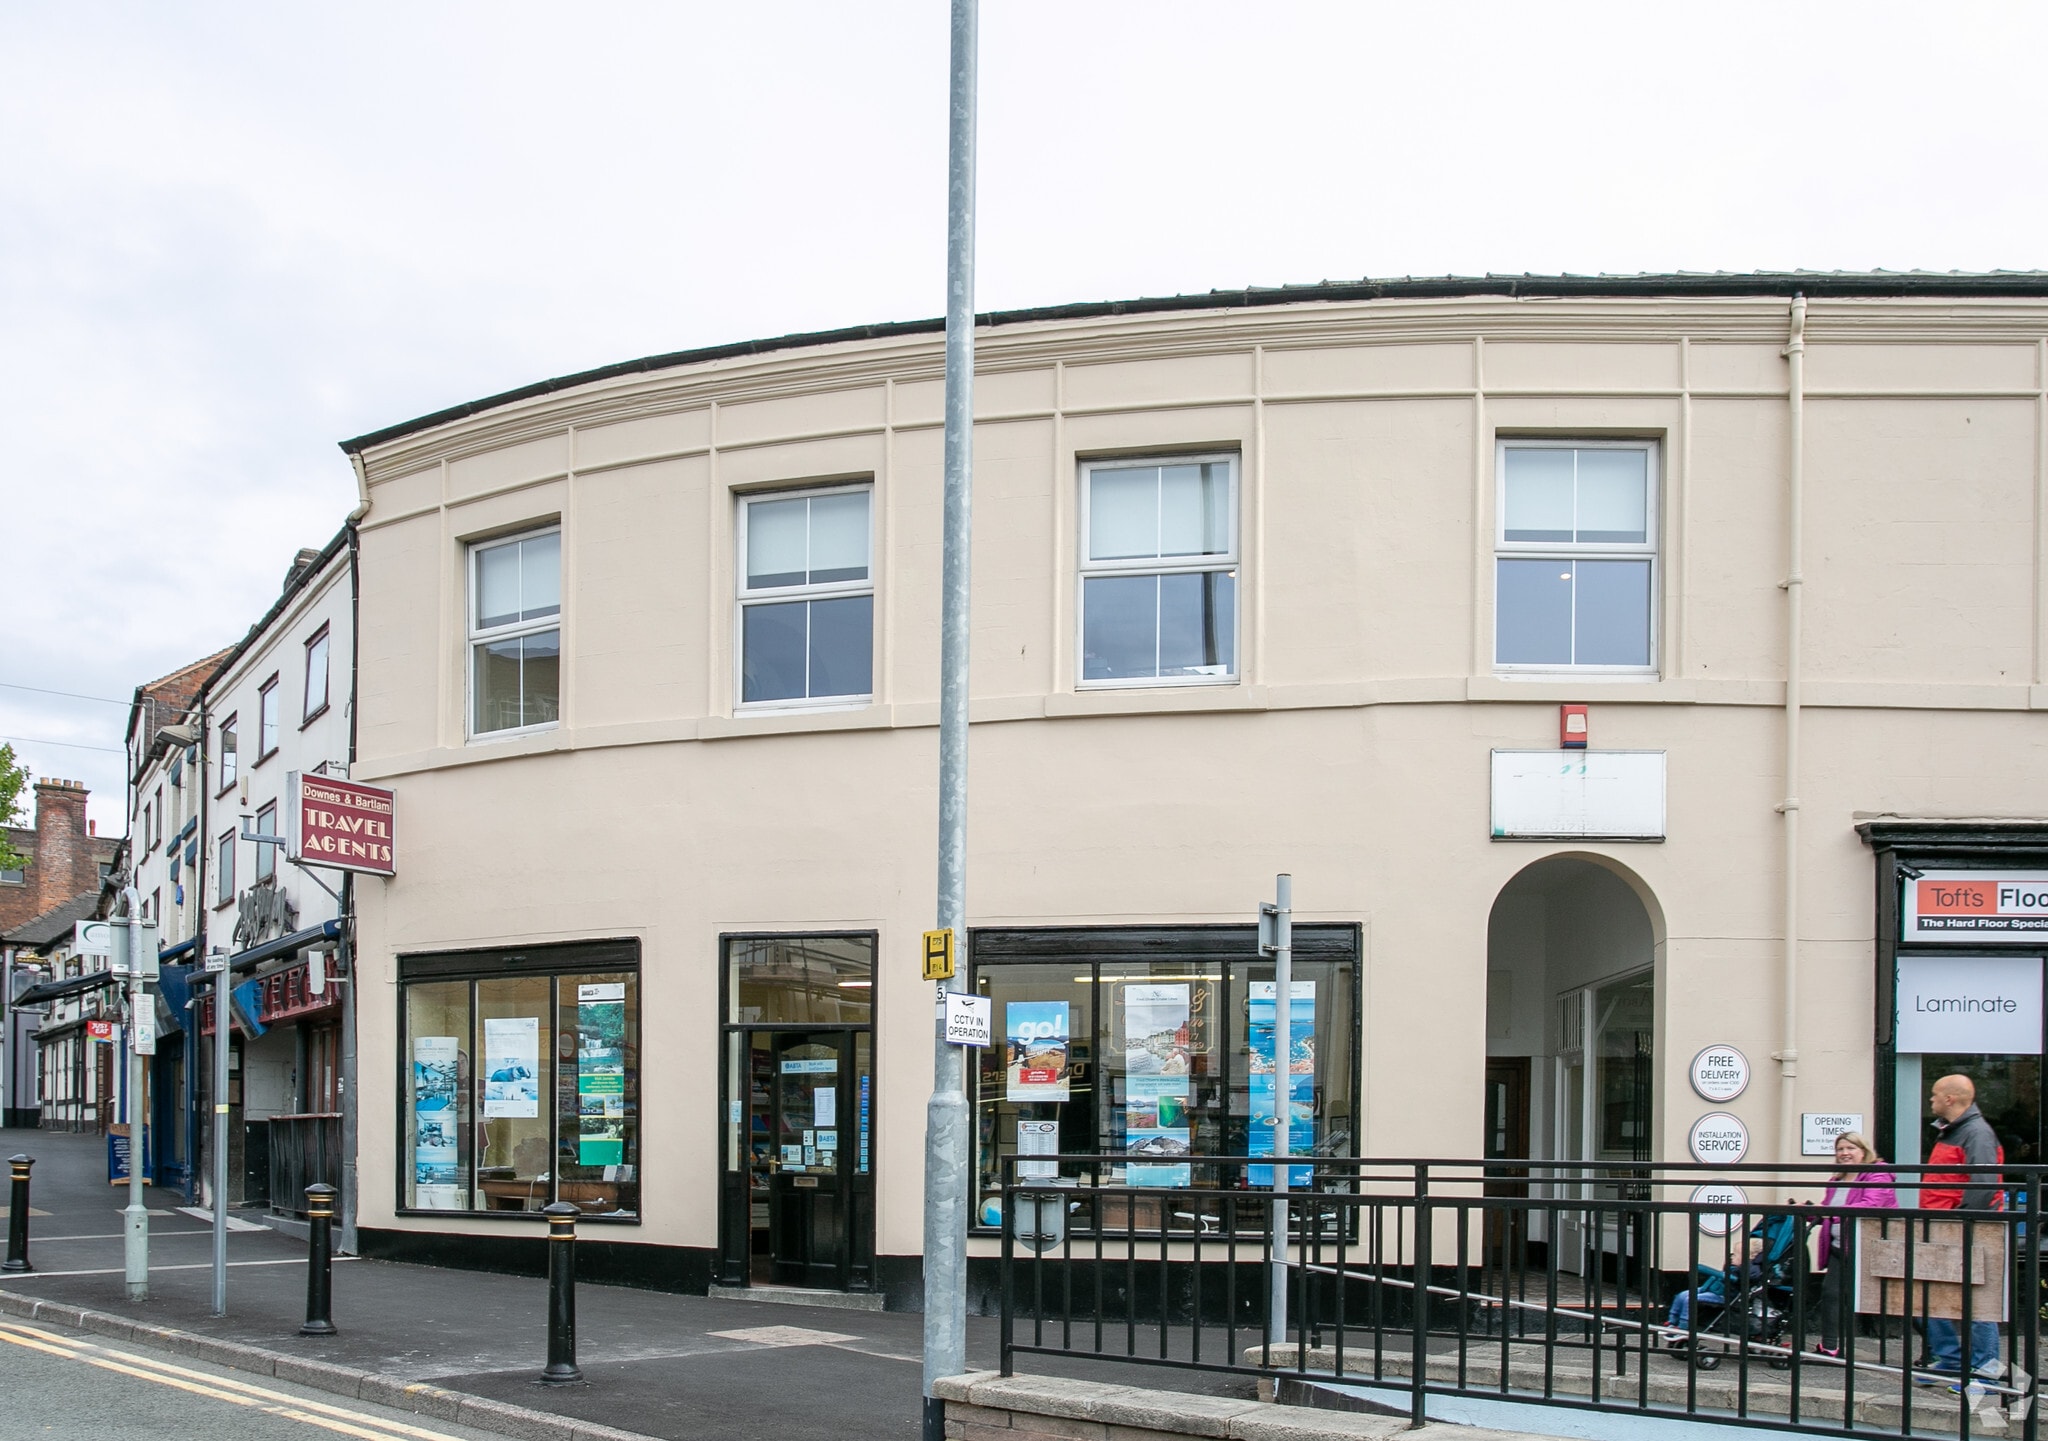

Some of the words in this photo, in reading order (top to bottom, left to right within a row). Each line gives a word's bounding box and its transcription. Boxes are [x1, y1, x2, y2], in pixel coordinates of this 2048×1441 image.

[304, 785, 341, 803] Downes
[344, 794, 352, 805] &
[355, 796, 390, 812] Bartlam
[304, 808, 391, 840] TRAVEL
[304, 833, 391, 862] AGENTS
[1930, 887, 1984, 907] Toft's
[1921, 919, 1944, 928] The
[1946, 919, 1975, 928] Hard
[1978, 919, 2009, 928] Floor
[1916, 995, 2017, 1013] Laminate
[954, 1014, 975, 1026] CCTV
[976, 1017, 984, 1027] IN
[948, 1026, 989, 1039] OPERATION
[1017, 1014, 1062, 1045] go!
[1708, 1056, 1734, 1067] FREE
[1700, 1070, 1741, 1080] DELIVERY
[1814, 1117, 1851, 1126] OPENING
[1698, 1131, 1742, 1139] INSTALLATION
[1821, 1127, 1845, 1136] TIMES
[1698, 1139, 1742, 1151] SERVICE
